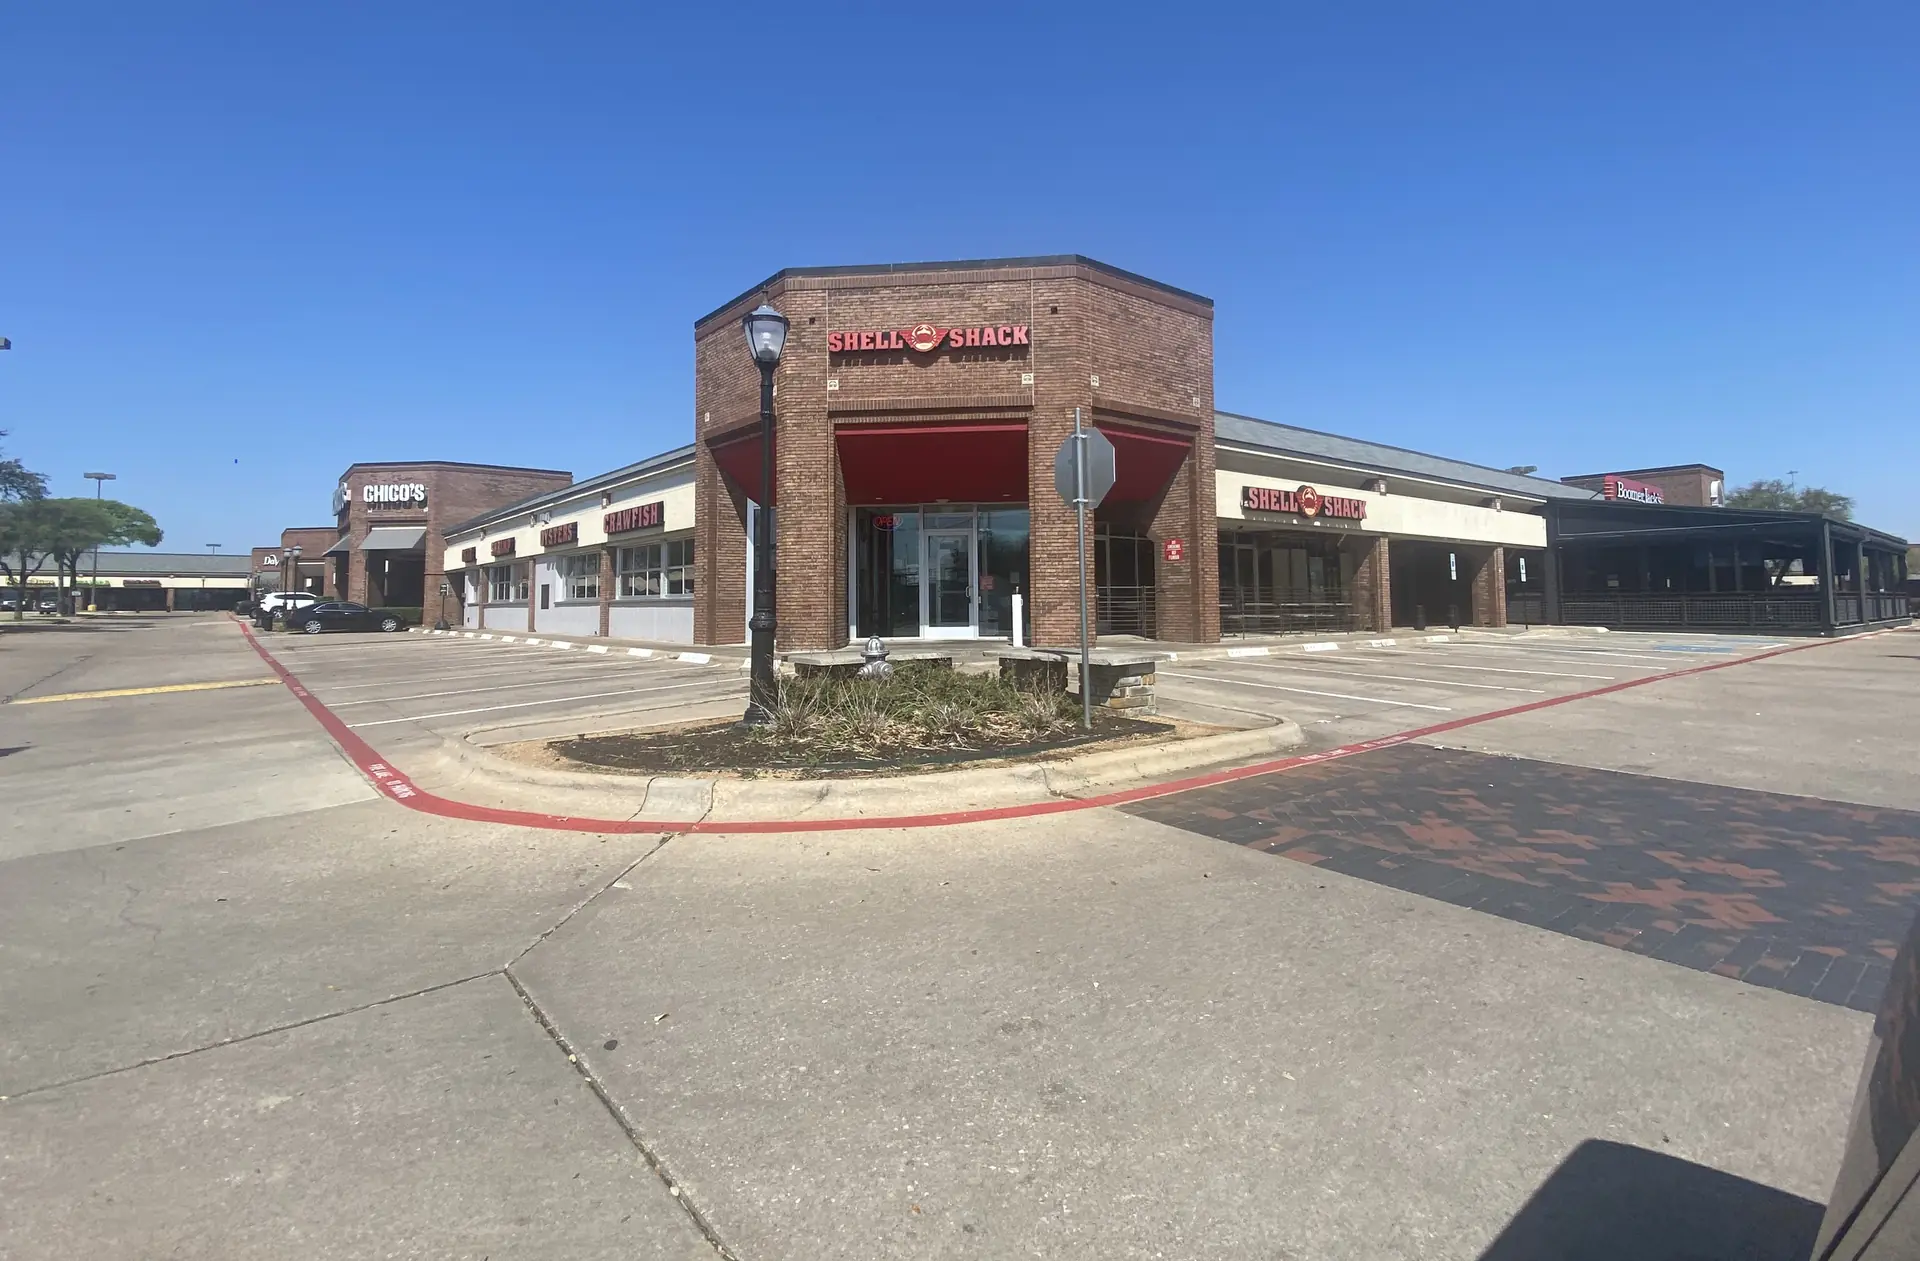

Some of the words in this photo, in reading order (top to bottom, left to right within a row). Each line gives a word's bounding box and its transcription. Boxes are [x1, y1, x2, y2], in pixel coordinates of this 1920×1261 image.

[828, 331, 903, 351] SHELL
[950, 326, 1028, 347] SHACK
[604, 503, 658, 533] CRAWFISH
[1248, 487, 1298, 512] SHELL
[1324, 496, 1367, 519] SHACK
